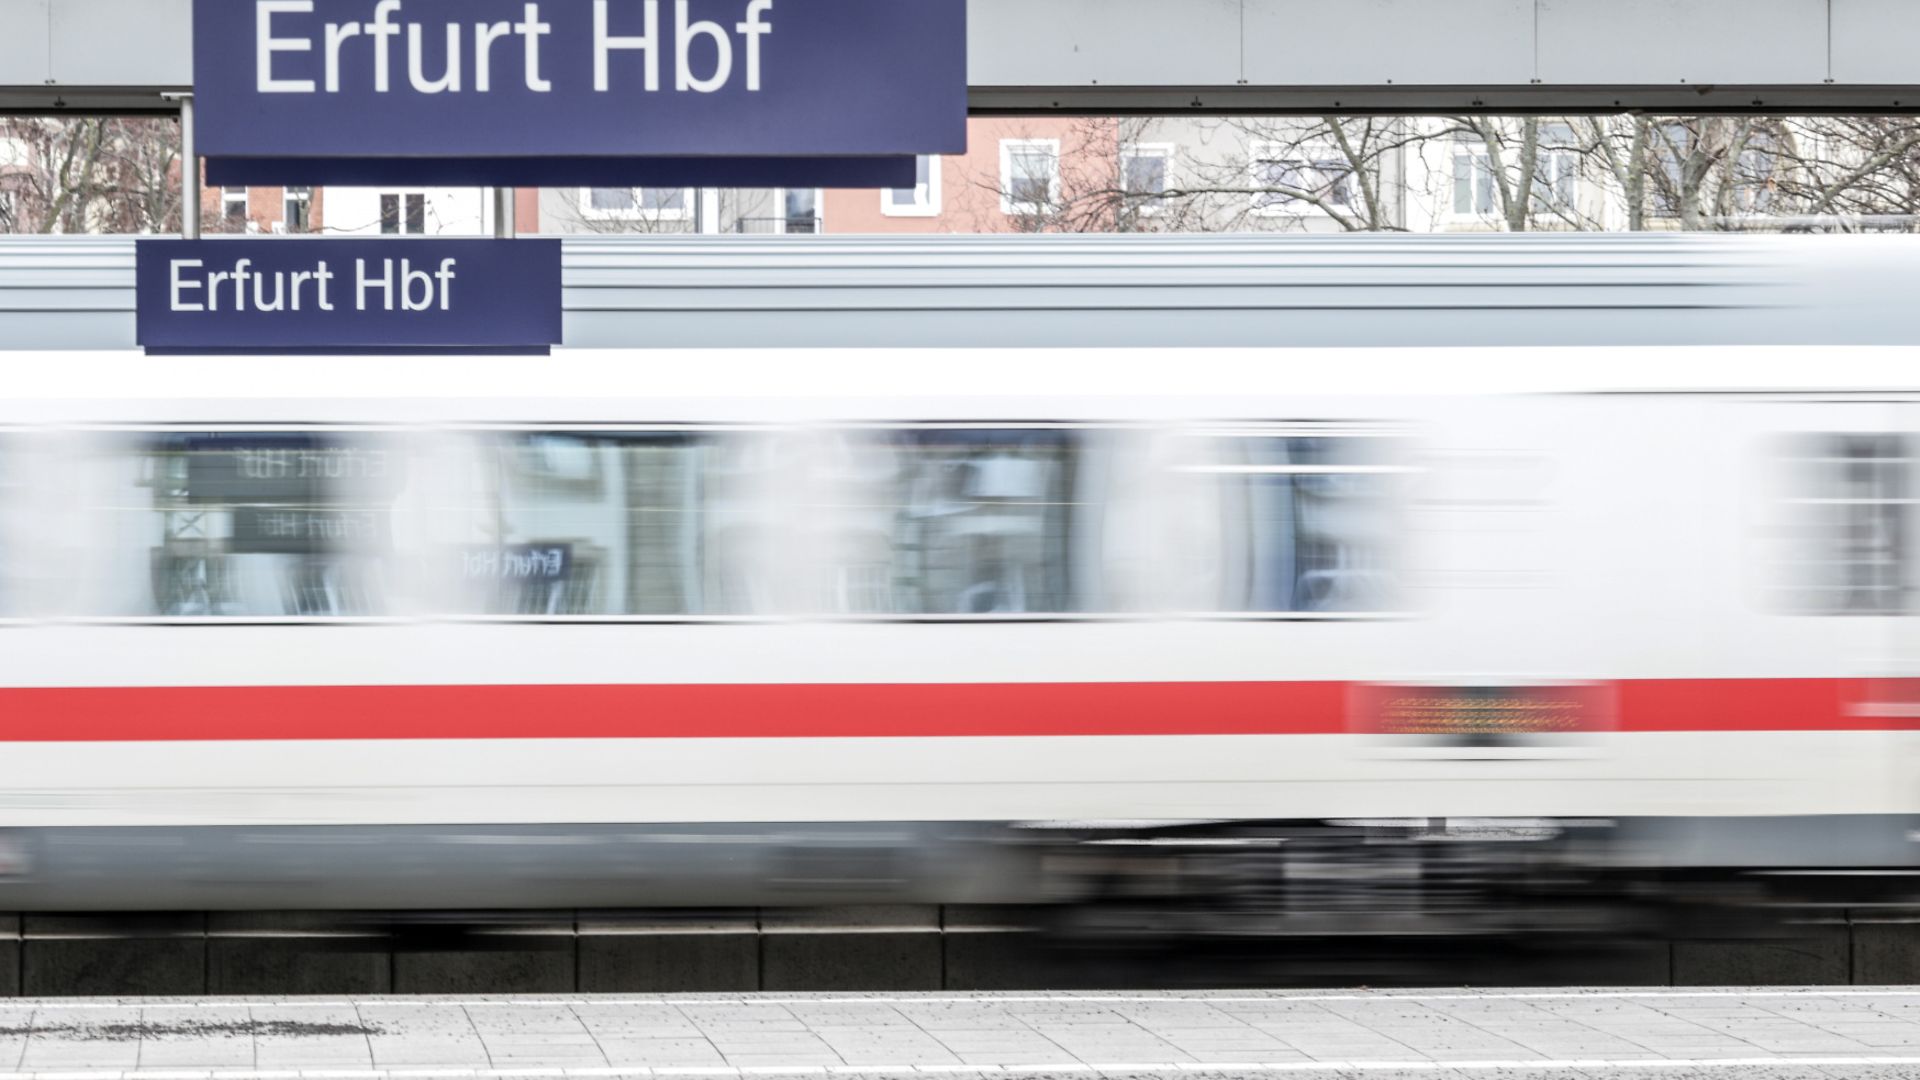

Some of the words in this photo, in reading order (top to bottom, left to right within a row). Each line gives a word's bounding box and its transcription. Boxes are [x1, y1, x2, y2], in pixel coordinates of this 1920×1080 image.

[256, 0, 552, 94] Erfurt
[593, 0, 773, 93] Hbf
[169, 258, 335, 312] Erfurt
[354, 257, 456, 312] Hbf
